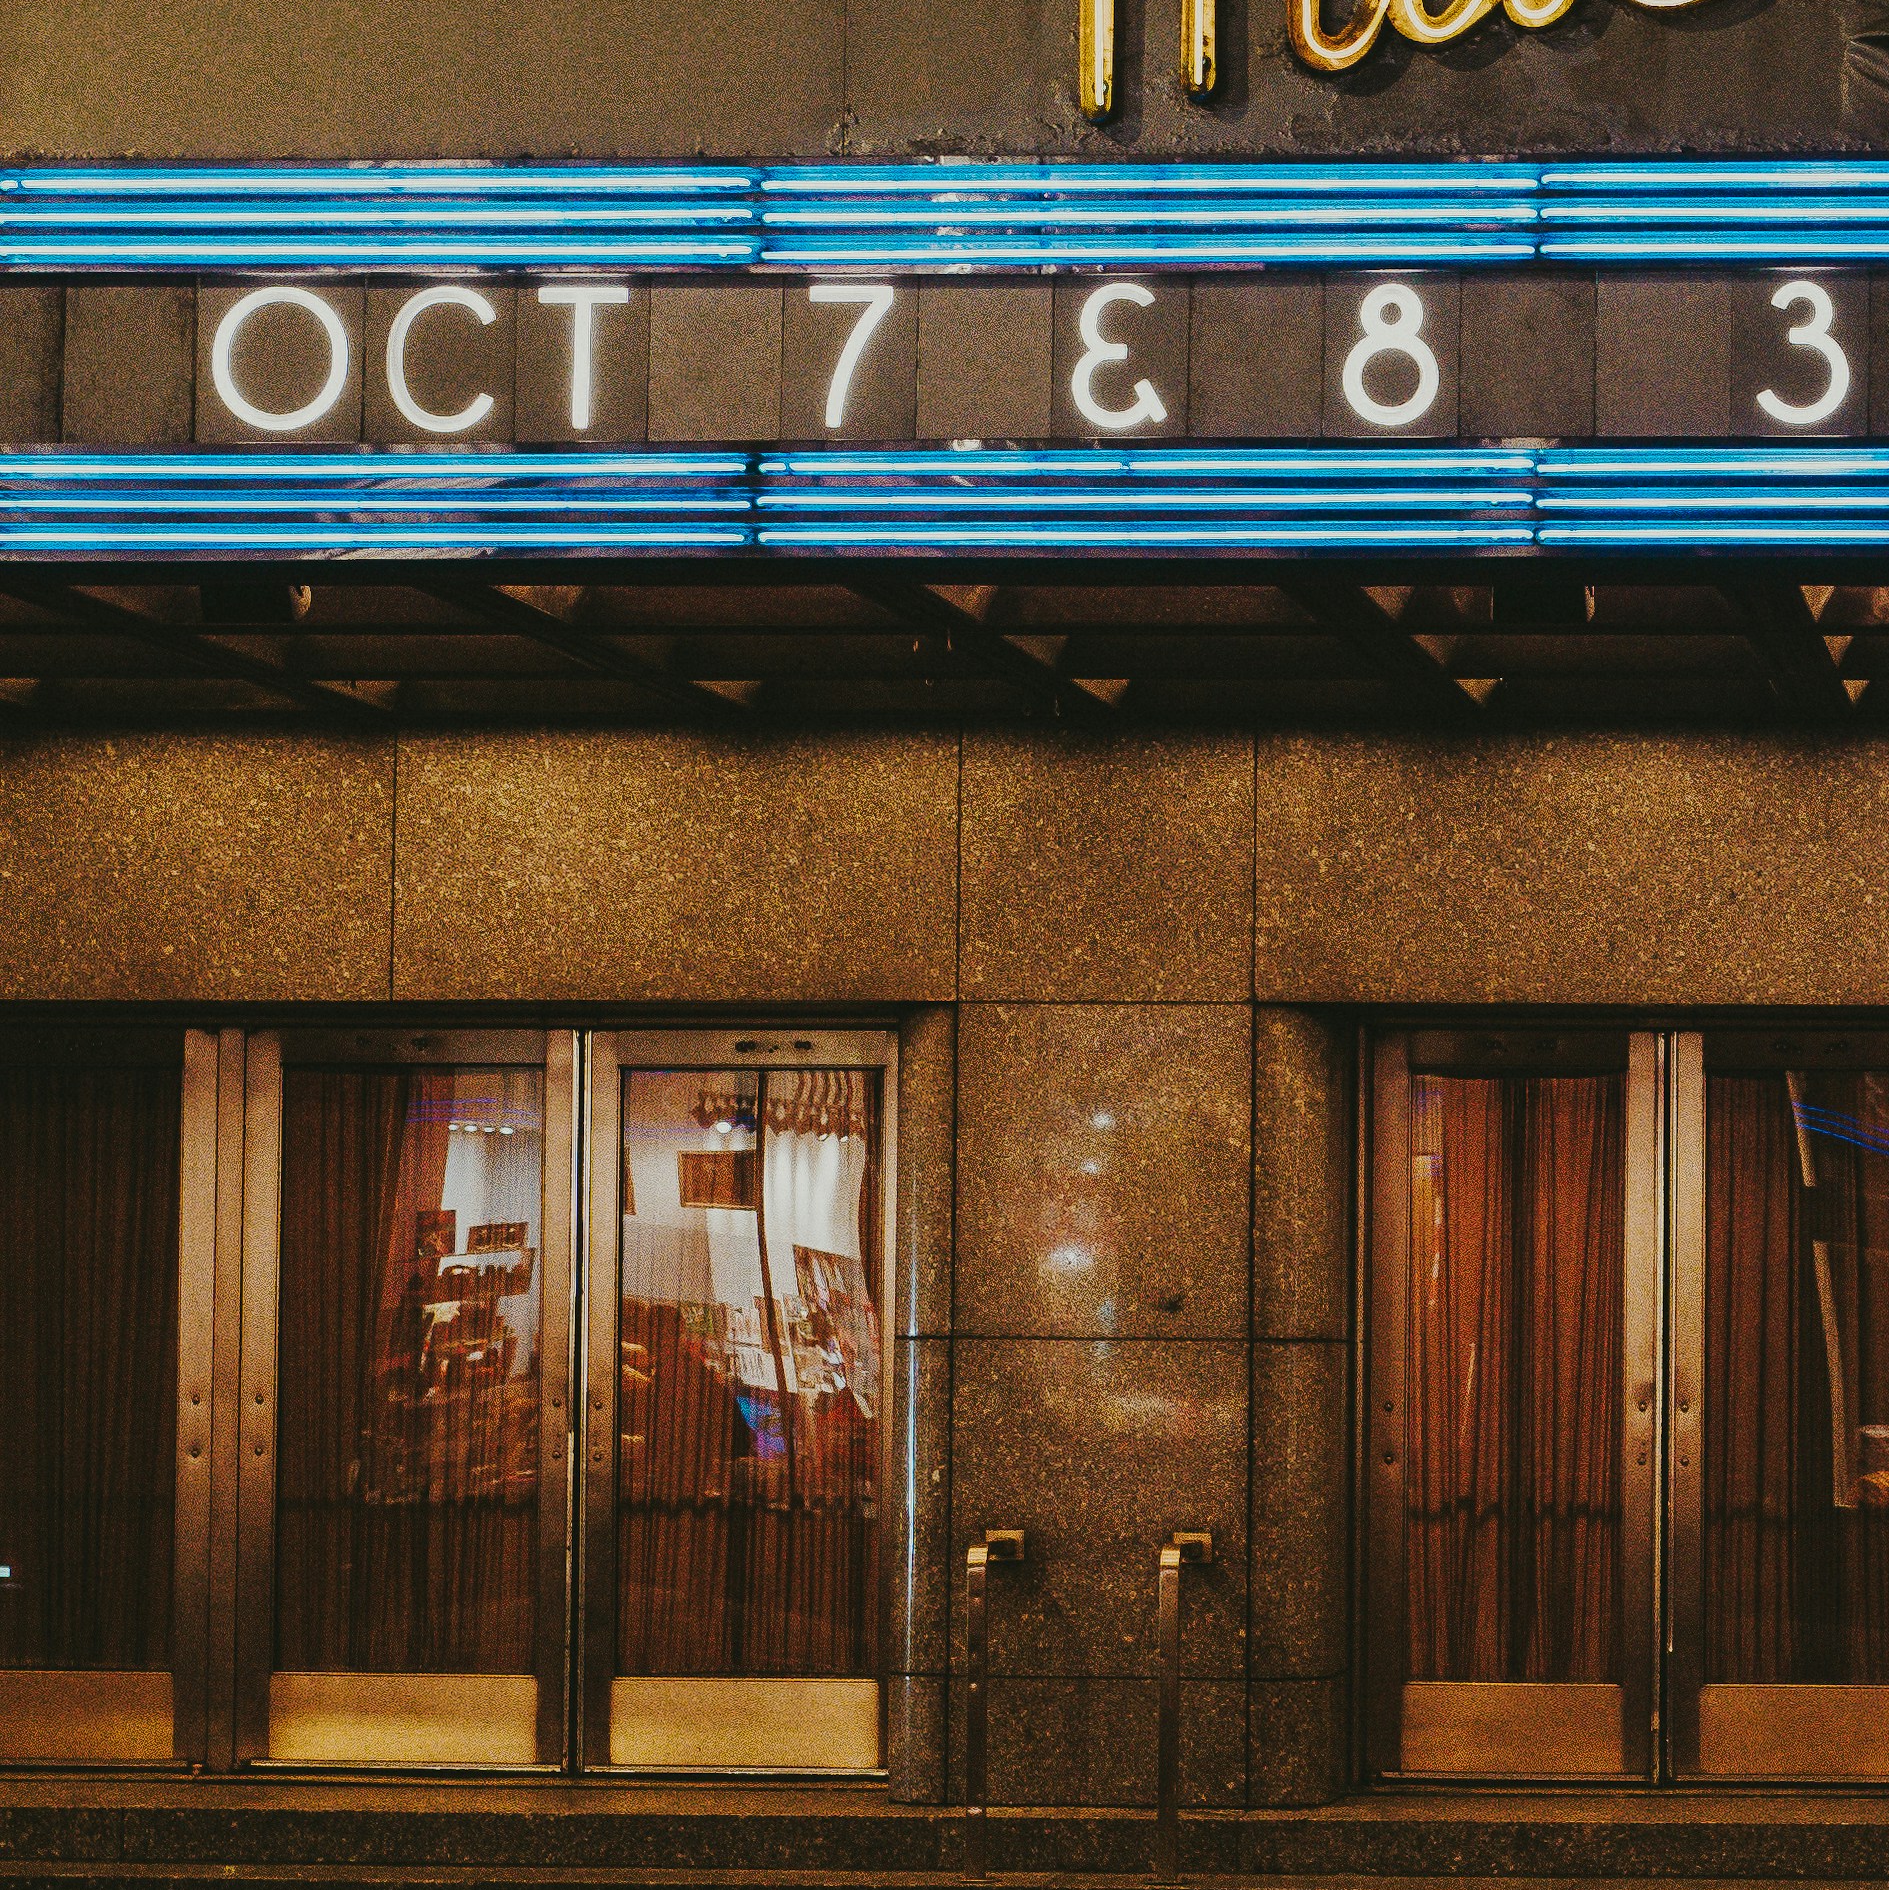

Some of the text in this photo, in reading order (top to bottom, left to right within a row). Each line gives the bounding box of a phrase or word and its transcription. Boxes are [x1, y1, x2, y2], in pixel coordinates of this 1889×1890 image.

[211, 285, 630, 433] OCT
[808, 283, 897, 429] 7
[1071, 281, 1169, 434] &
[1341, 282, 1440, 429] 8
[1756, 279, 1851, 428] 3
